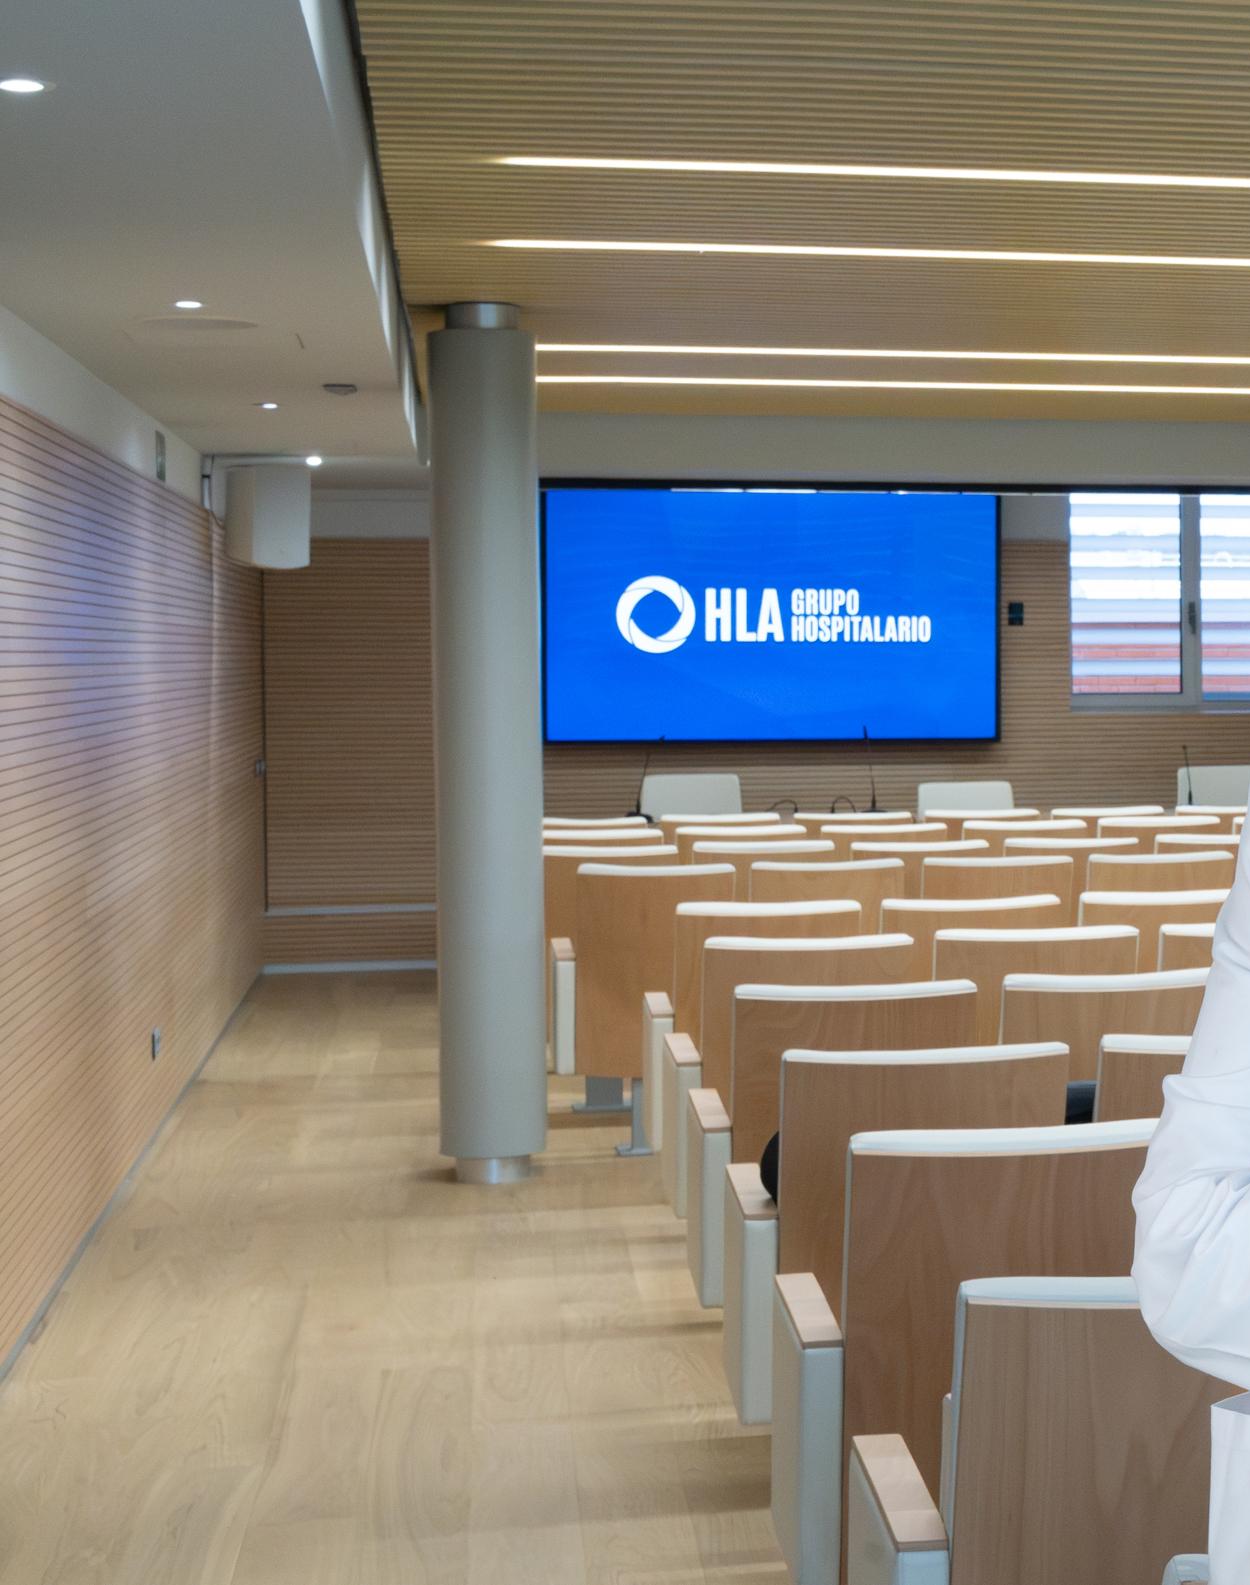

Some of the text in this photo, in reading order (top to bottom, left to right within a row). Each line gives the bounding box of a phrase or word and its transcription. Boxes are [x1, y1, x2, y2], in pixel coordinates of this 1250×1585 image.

[705, 587, 785, 642] HLA
[791, 588, 860, 616] GRUPO
[791, 615, 932, 643] HOSPITALARIO
